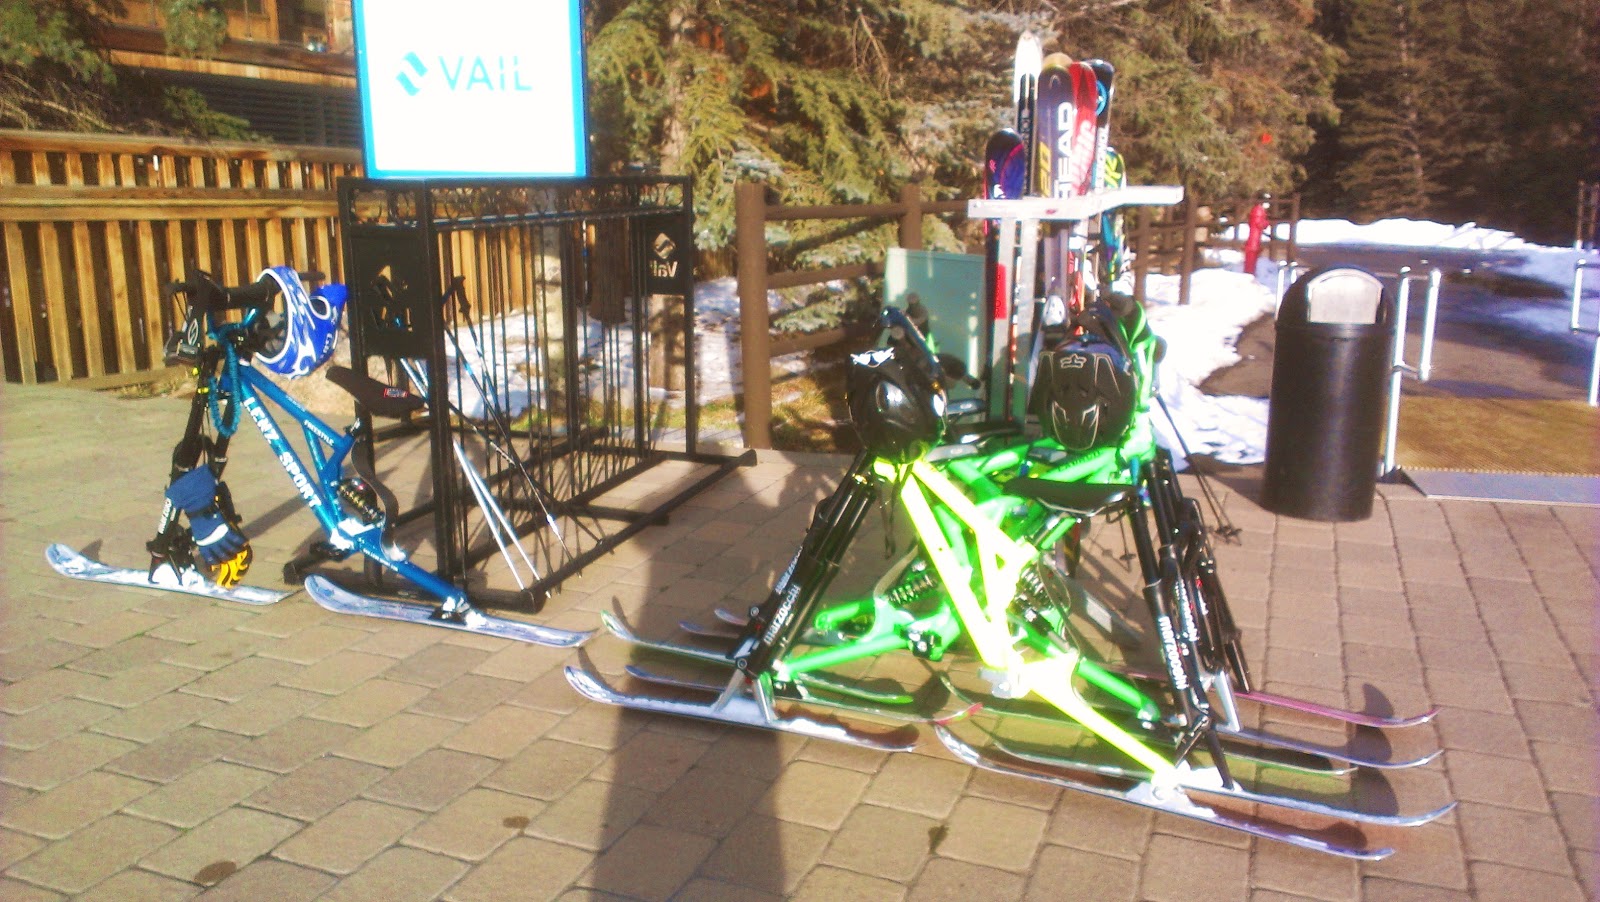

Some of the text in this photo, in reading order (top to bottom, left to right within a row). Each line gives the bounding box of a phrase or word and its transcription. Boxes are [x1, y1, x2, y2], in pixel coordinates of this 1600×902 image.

[438, 56, 533, 92] VAIL
[243, 396, 280, 445] LENZ
[279, 451, 322, 507] SPORT
[763, 583, 802, 645] marzocchi
[1157, 616, 1189, 690] marzocchi
